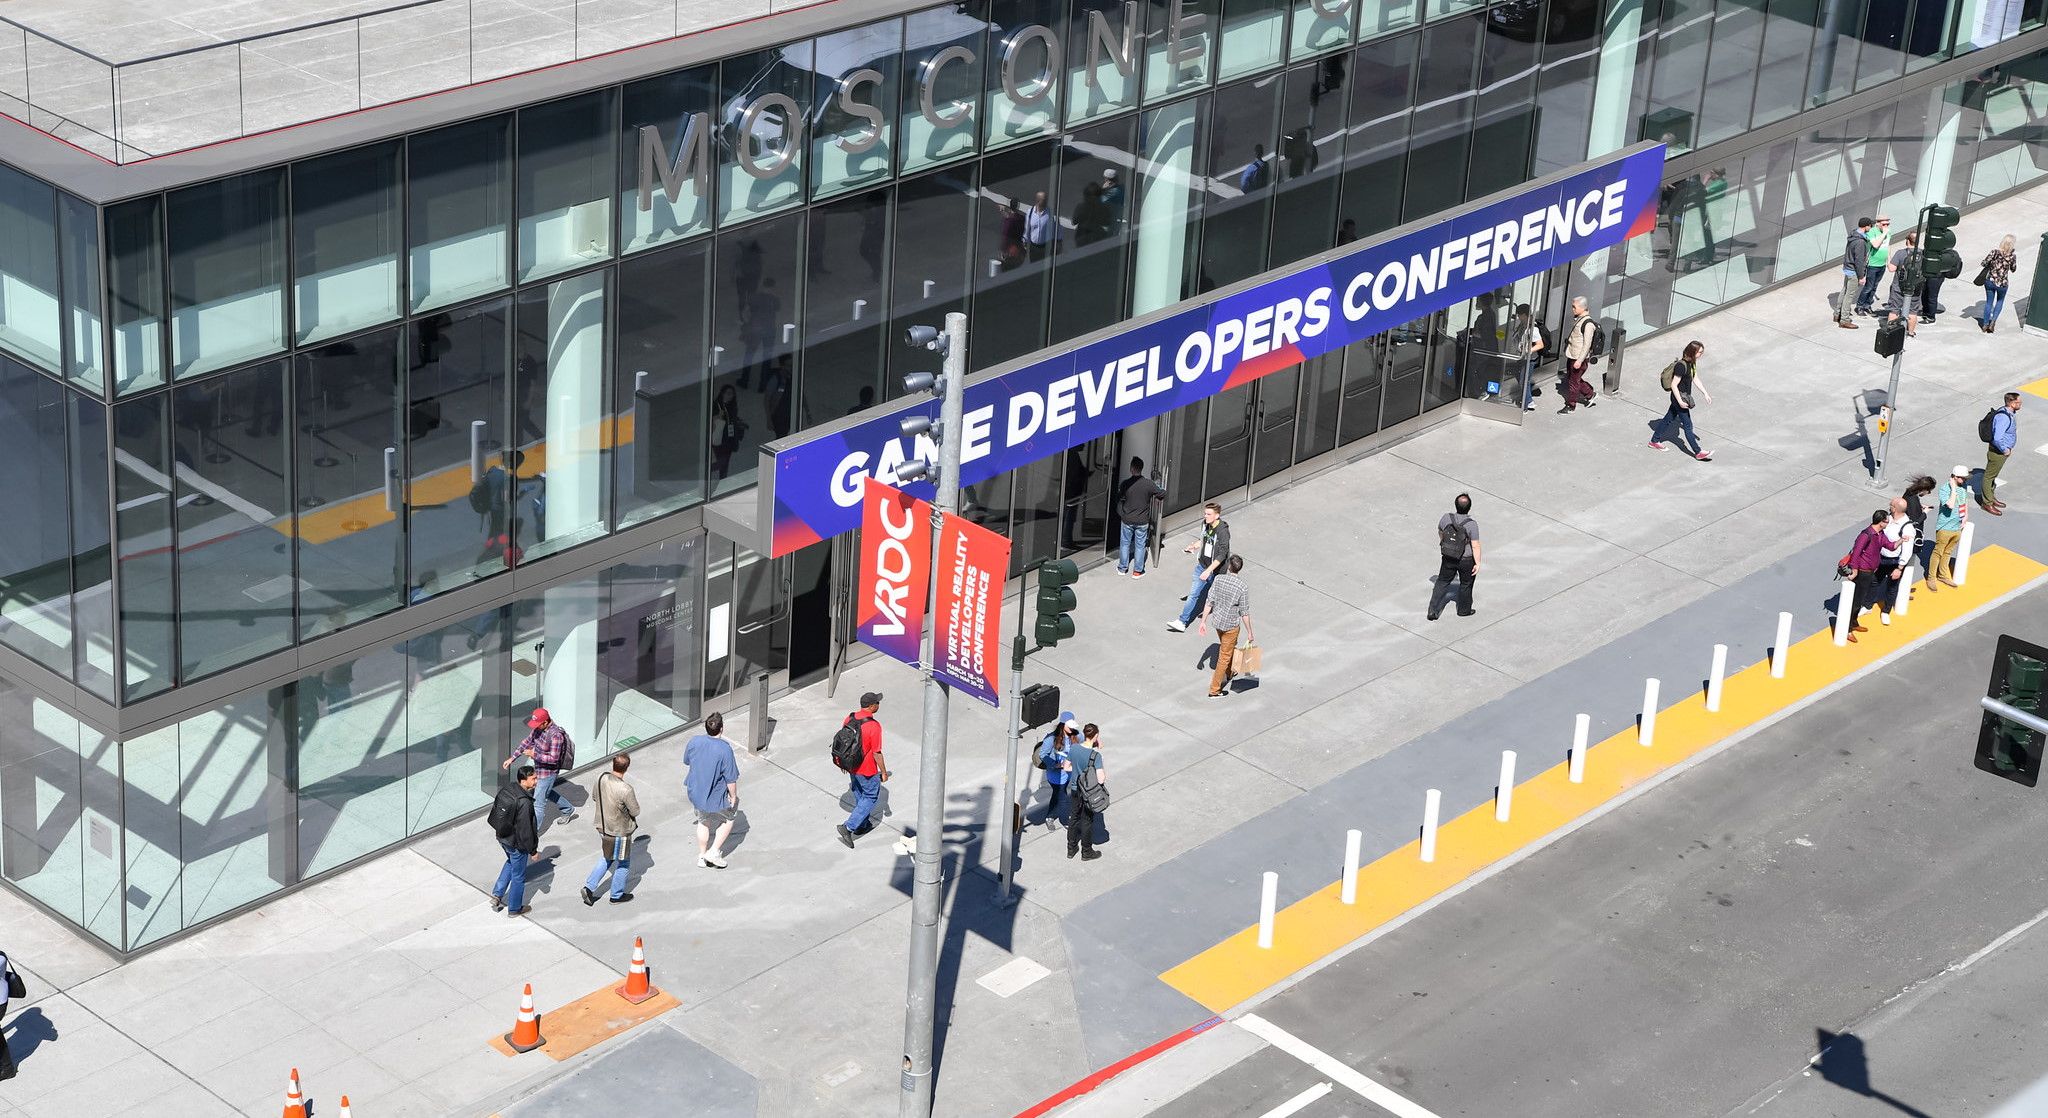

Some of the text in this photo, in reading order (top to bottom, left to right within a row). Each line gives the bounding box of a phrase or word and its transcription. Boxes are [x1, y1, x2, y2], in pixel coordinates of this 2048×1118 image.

[637, 0, 1207, 212] MOSCONE
[1006, 286, 1333, 448] DEVELOPERS
[1342, 178, 1628, 322] CONFERENCE
[646, 599, 693, 623] NORTH LOBBY
[872, 497, 914, 637] VRDC
[948, 530, 969, 661] VIRTUAL REALITY
[960, 564, 978, 670] DEVELOPERS
[973, 570, 990, 675] CONFERENCE
[946, 661, 967, 676] MARCH
